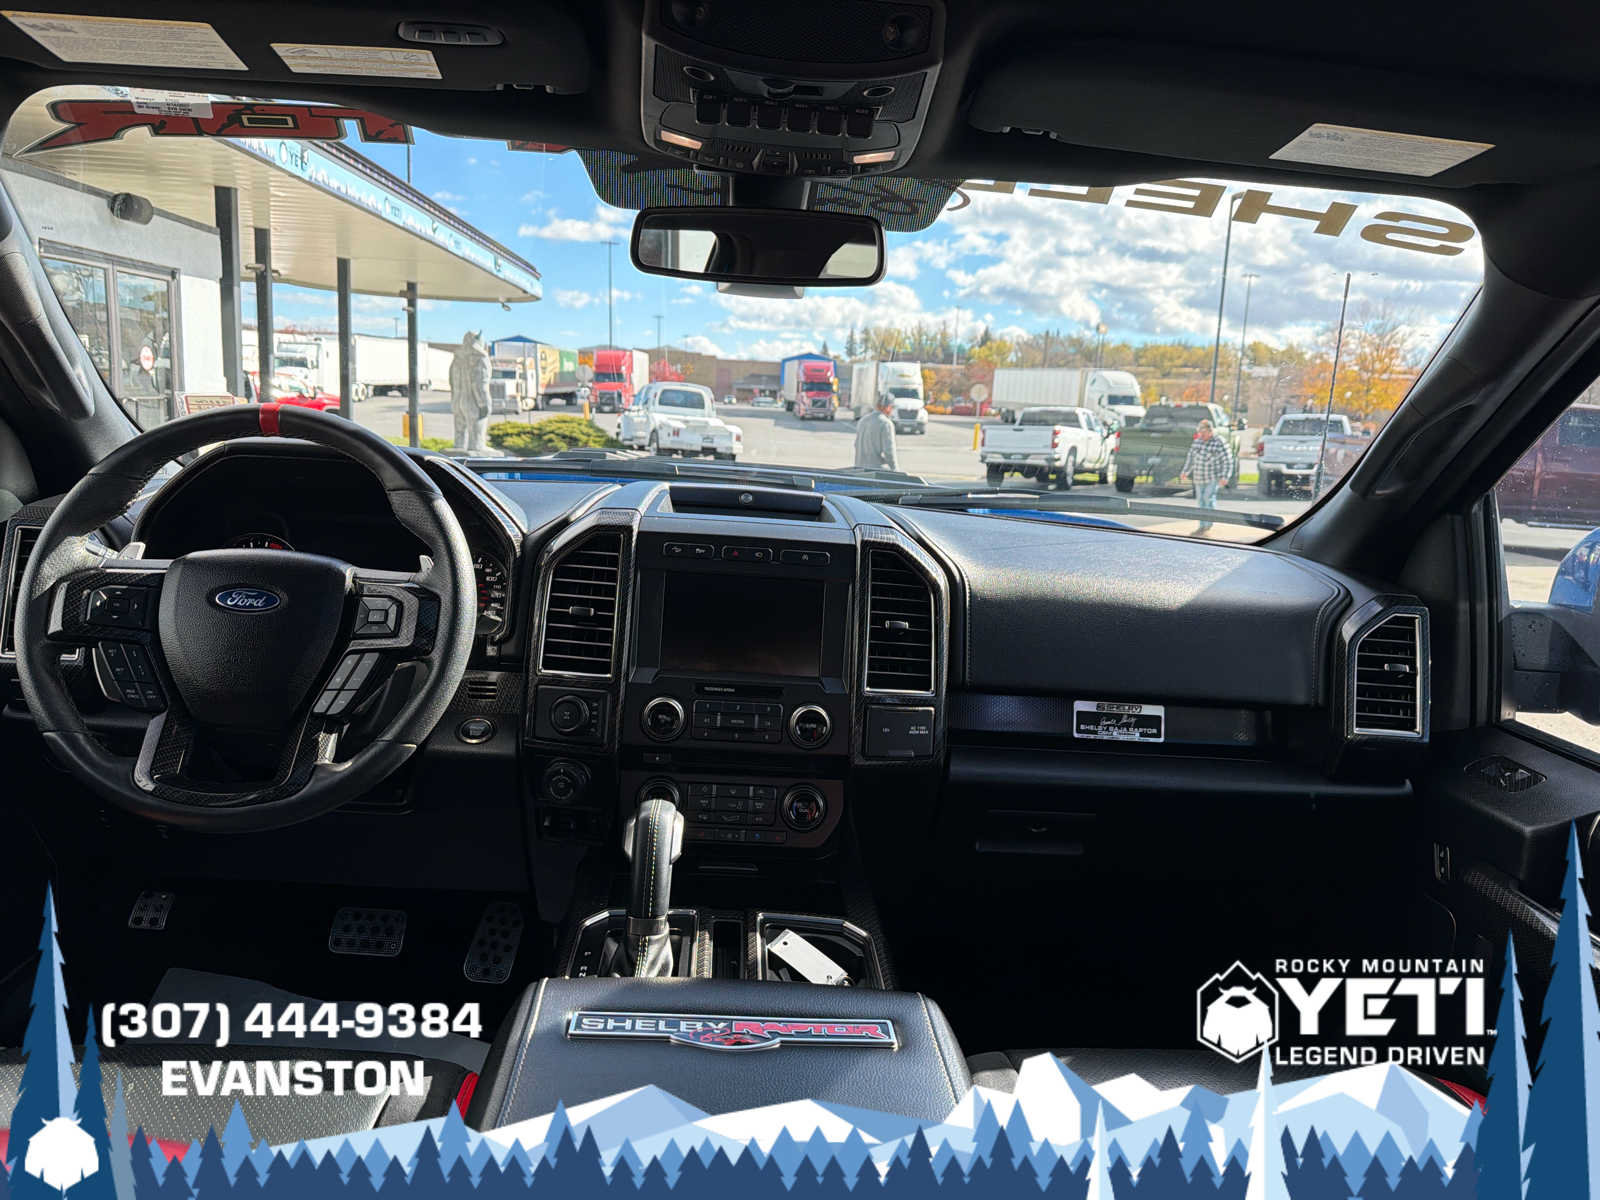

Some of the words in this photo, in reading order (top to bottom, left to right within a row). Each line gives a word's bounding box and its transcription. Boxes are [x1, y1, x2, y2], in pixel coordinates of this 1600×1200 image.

[226, 590, 267, 608] Ford
[1080, 724, 1107, 732] SHELBY
[581, 1016, 731, 1034] SHELBY
[732, 1020, 887, 1039] RAPTOR
